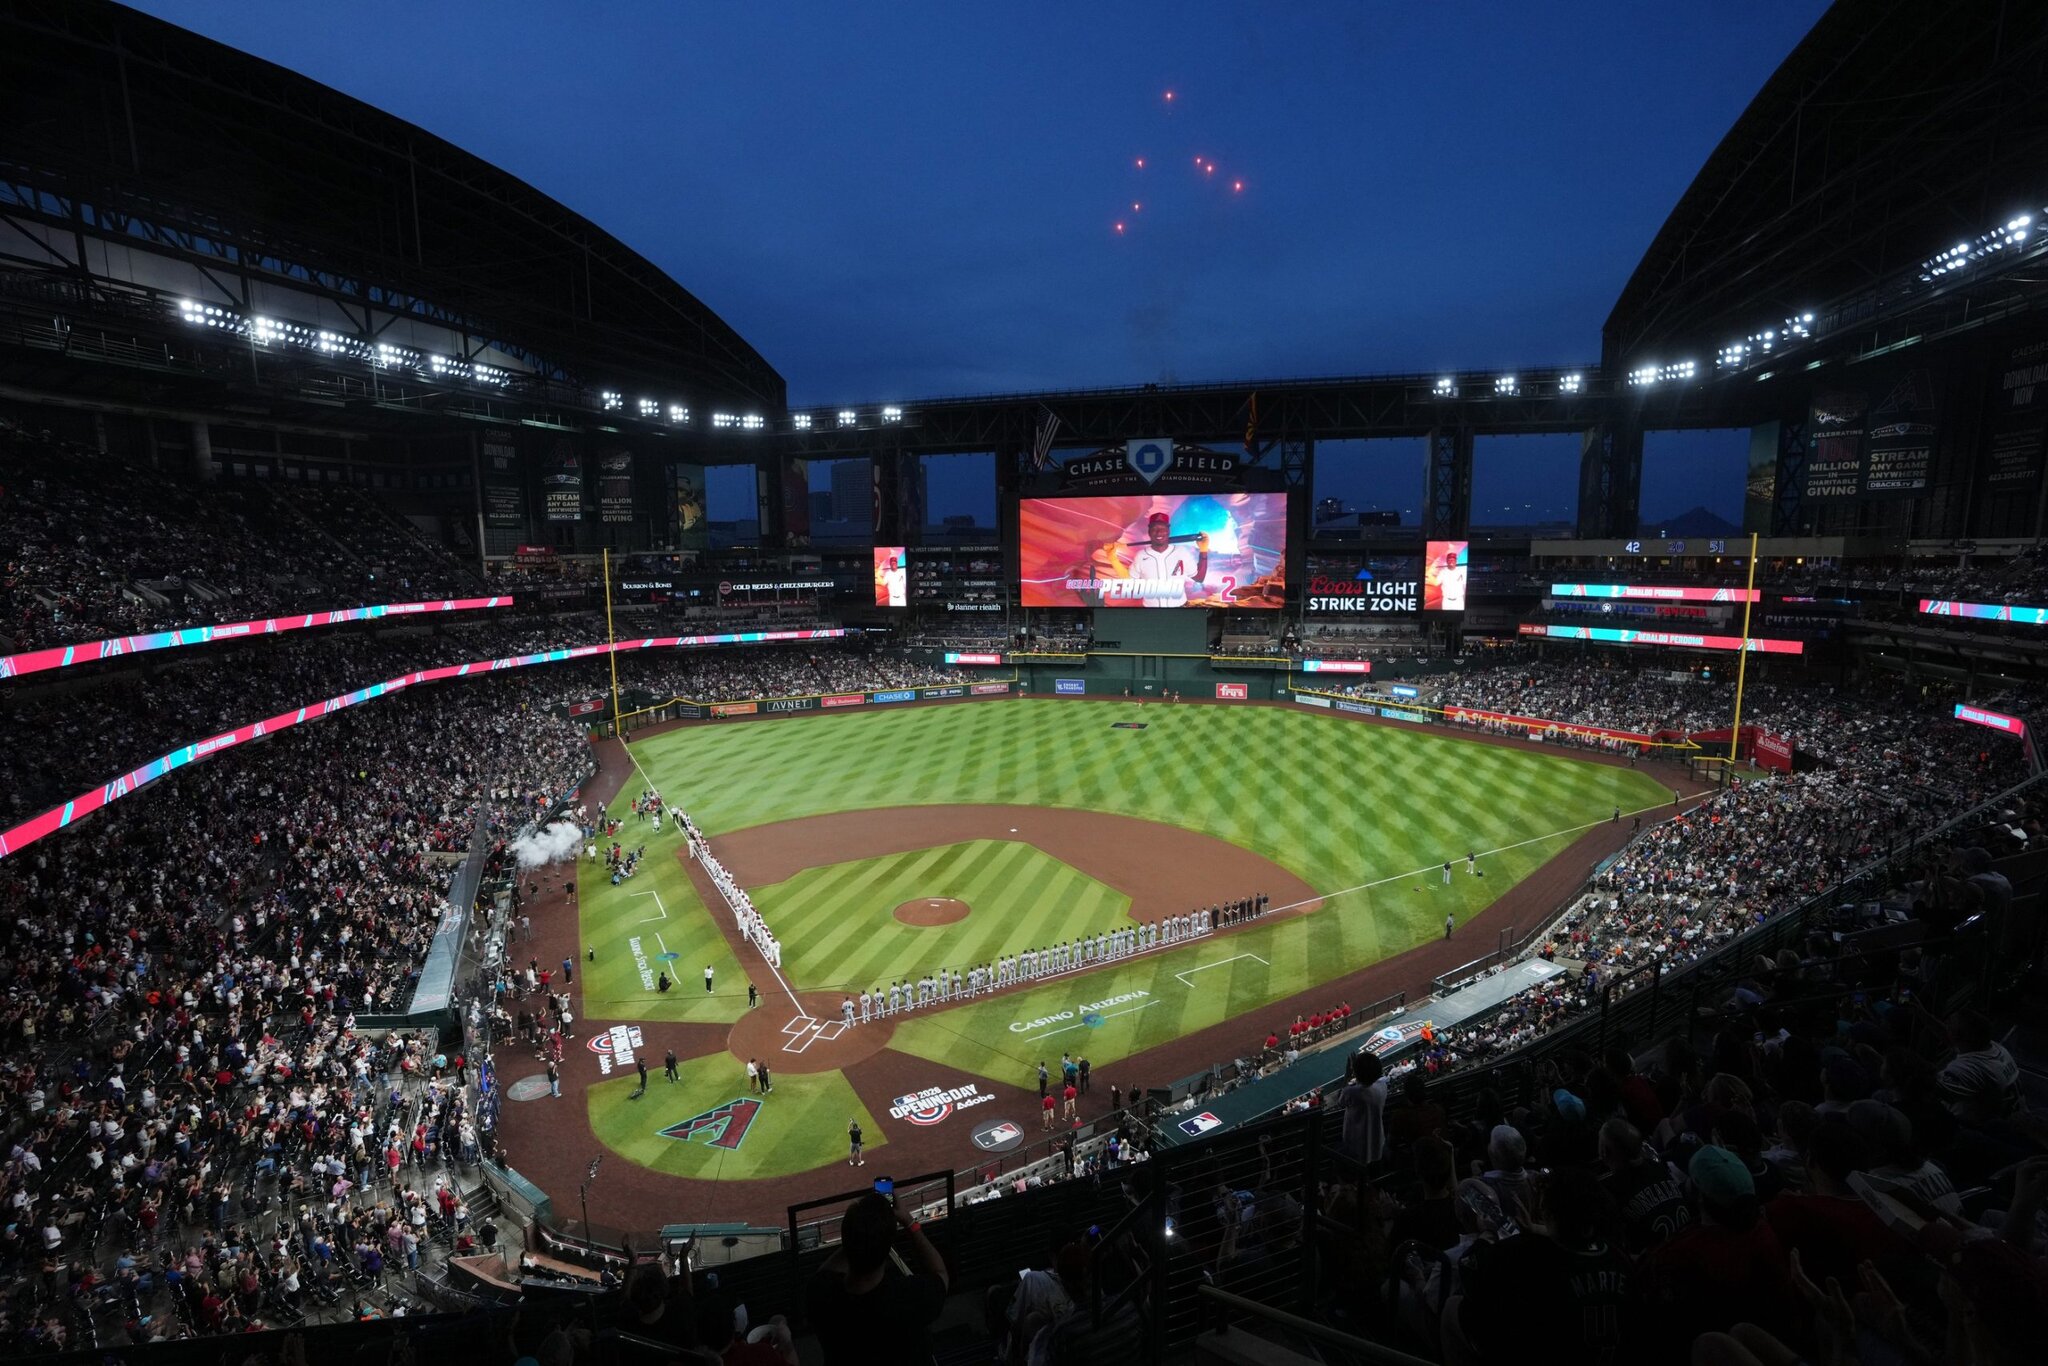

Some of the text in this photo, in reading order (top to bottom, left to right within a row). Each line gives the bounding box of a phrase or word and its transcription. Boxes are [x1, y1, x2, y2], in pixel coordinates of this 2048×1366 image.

[1812, 429, 1864, 438] CELEBRATING
[1871, 450, 1929, 462] STREAM
[1070, 457, 1232, 475] CHASE FIELD
[1809, 460, 1860, 471] MILLION
[1870, 461, 1928, 471] ANY GAME
[1868, 470, 1927, 479] ANYWHERE
[1807, 478, 1858, 486] CHARITABLE
[1806, 485, 1857, 497] GIVING
[1625, 542, 1640, 553] 42
[1099, 579, 1185, 599] PERDOMO
[1221, 576, 1236, 602] 2
[1311, 576, 1417, 596] Coors LIGHT
[1310, 597, 1417, 611] STRIKE ZONE
[879, 693, 903, 701] CHASE
[1220, 685, 1244, 697] fry's
[772, 699, 808, 710] AVNET
[889, 1083, 979, 1119] OPENING DAY
[956, 1093, 996, 1110] Adobe
